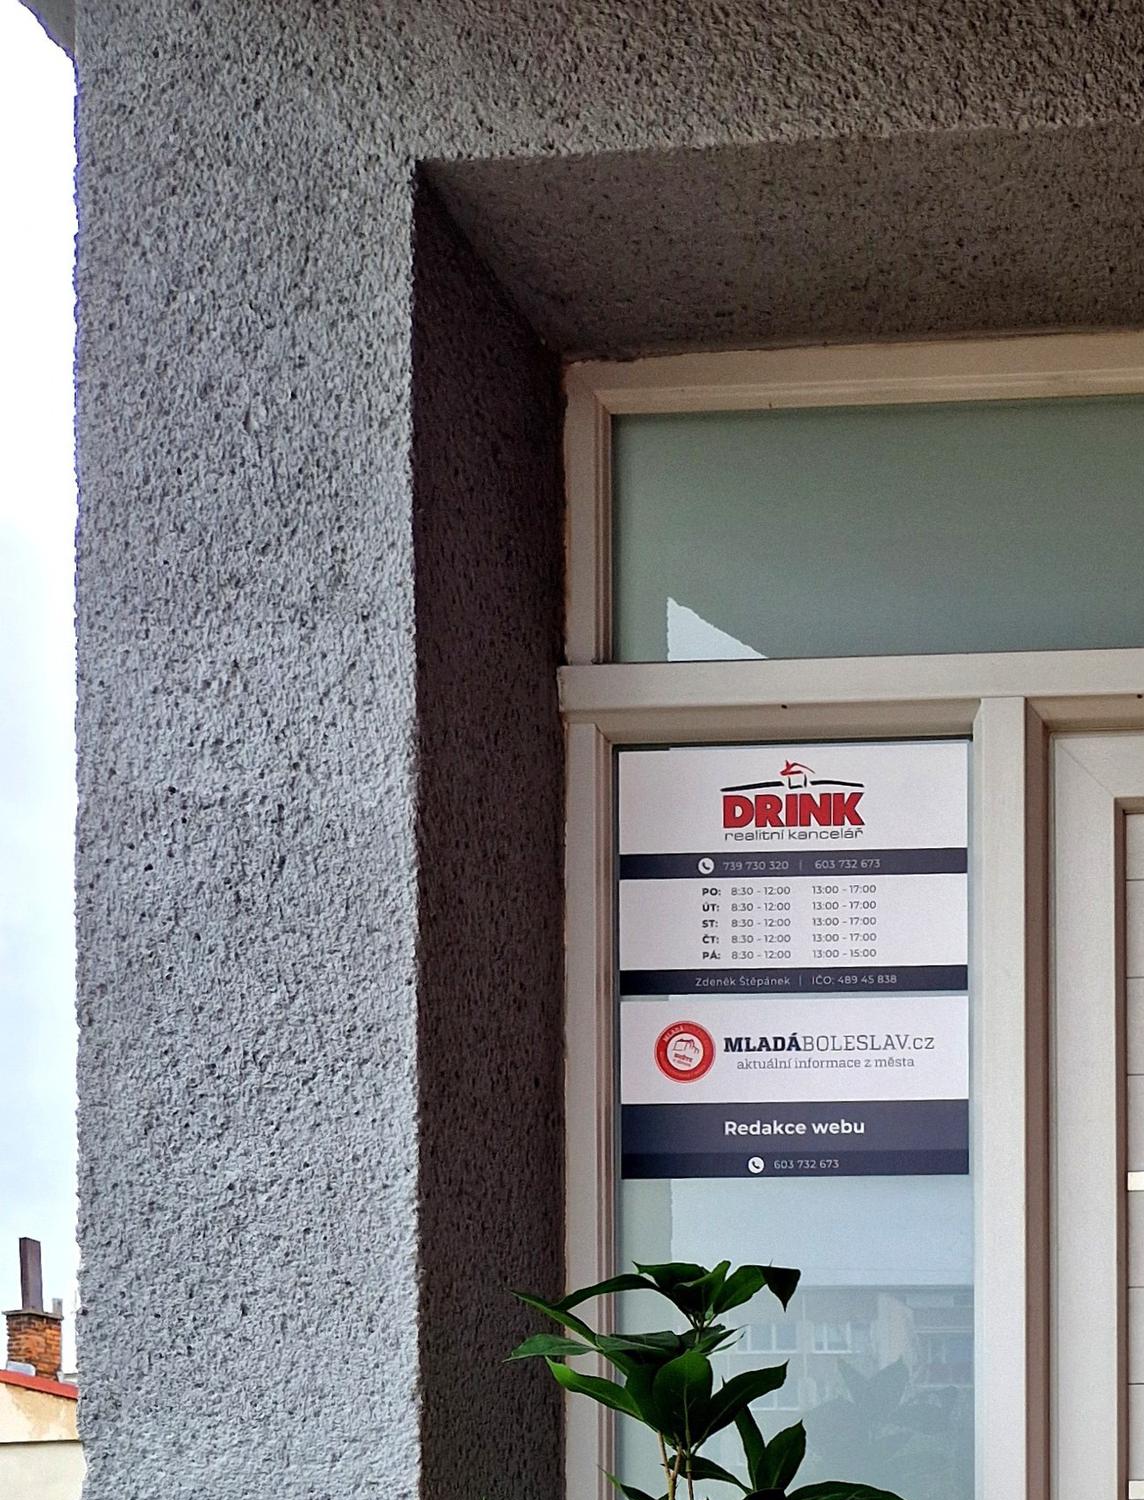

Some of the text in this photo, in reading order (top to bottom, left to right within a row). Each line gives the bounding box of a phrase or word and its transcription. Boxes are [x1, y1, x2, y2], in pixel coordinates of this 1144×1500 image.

[723, 792, 865, 828] DRINK
[725, 828, 863, 841] realitní kancelář
[723, 859, 880, 870] 739 730 320 603 732 673
[702, 888, 721, 896] PO:
[763, 887, 791, 895] 12:00
[812, 886, 839, 894] 13:00
[849, 885, 877, 893] 17:00
[702, 902, 720, 912] ÚT:
[731, 904, 753, 912] 8:30
[763, 903, 791, 911] 12:00
[812, 902, 839, 910] 13:00
[849, 901, 877, 909] 17:00
[702, 919, 718, 928] ST:
[731, 920, 753, 928] 8:30
[763, 919, 791, 927] 12:00
[812, 918, 839, 926] 13:00
[849, 917, 877, 925] 17:00
[702, 934, 719, 944] ČT:
[731, 936, 753, 944] 8:30
[763, 935, 791, 943] 12:00
[812, 934, 839, 942] 13:00
[849, 933, 877, 941] 17:00
[702, 950, 721, 960] PÁ:
[731, 952, 753, 960] 8:30
[763, 951, 791, 959] 12:00
[812, 950, 839, 958] 13:00
[849, 949, 877, 957] 15:00
[696, 974, 897, 988] Zdeněk Štěpánek IČO: 489 45 838
[737, 1057, 914, 1070] aktuální informace z města
[724, 1119, 865, 1135] Redakce webu
[774, 1160, 839, 1169] 603 732 673
